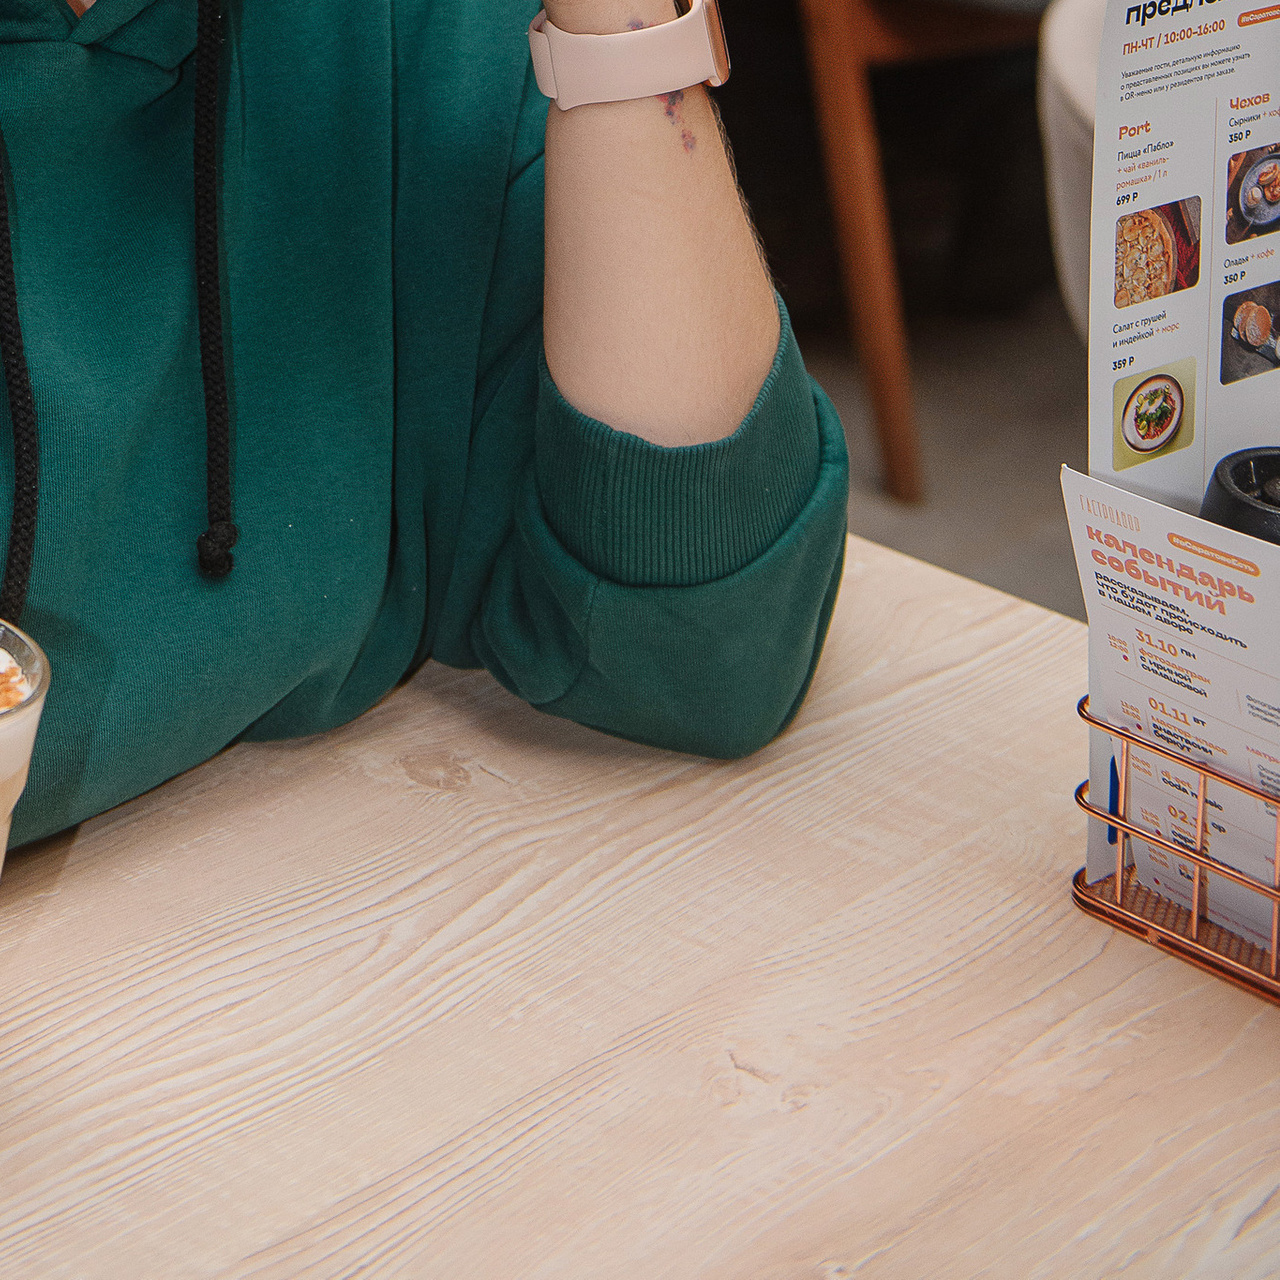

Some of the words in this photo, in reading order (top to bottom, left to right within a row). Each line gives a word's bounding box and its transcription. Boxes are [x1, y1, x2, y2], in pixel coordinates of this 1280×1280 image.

[1122, 37, 1155, 56] ПН-ЧТ
[1121, 66, 1154, 79] Уважаемые
[1171, 53, 1202, 68] детальную
[1203, 44, 1241, 57] информацию
[1125, 72, 1173, 90] представленных
[1173, 65, 1201, 77] позициях
[1210, 57, 1231, 67] можете
[1231, 52, 1251, 64] узнать
[1124, 88, 1153, 100] QR-меню
[1153, 85, 1165, 93] или
[1169, 75, 1203, 91] резидентов
[1204, 72, 1216, 80] при
[1229, 93, 1270, 110] Чехов
[1119, 121, 1151, 140] Port
[1229, 114, 1261, 127] Сырники
[1117, 149, 1141, 161] Пицца
[1142, 140, 1175, 154] «Пабло»
[1228, 131, 1243, 144] 350
[1123, 162, 1136, 173] чай
[1116, 174, 1152, 192] ромашка»
[1116, 193, 1131, 206] 699
[1257, 248, 1275, 259] кофе
[1223, 272, 1238, 285] 350
[1112, 321, 1134, 334] Салат
[1140, 310, 1167, 327] грушей
[1112, 340, 1118, 348] и
[1118, 328, 1155, 347] индейкой
[1161, 322, 1180, 333] морс
[1112, 358, 1127, 371] 359
[1085, 524, 1255, 604] календарь
[1091, 548, 1226, 616] событий
[1094, 571, 1190, 618] рассказываем,
[1096, 580, 1119, 595] что
[1121, 589, 1158, 612] будет
[1160, 606, 1248, 649] происходить
[1098, 588, 1106, 598] в
[1108, 593, 1152, 618] нашем
[1154, 615, 1194, 635] дворе
[1134, 627, 1179, 657] 31.10
[1180, 647, 1197, 661] пн
[1138, 647, 1211, 685] фотозавтрак
[1139, 655, 1147, 663] с
[1148, 659, 1193, 684] ириной
[1141, 663, 1209, 699] симашовой
[1148, 696, 1192, 726] 01.11
[1192, 716, 1207, 727] вт
[1151, 715, 1228, 756] мастер-класс
[1152, 722, 1214, 757] анастасии
[1153, 729, 1192, 753] беркут
